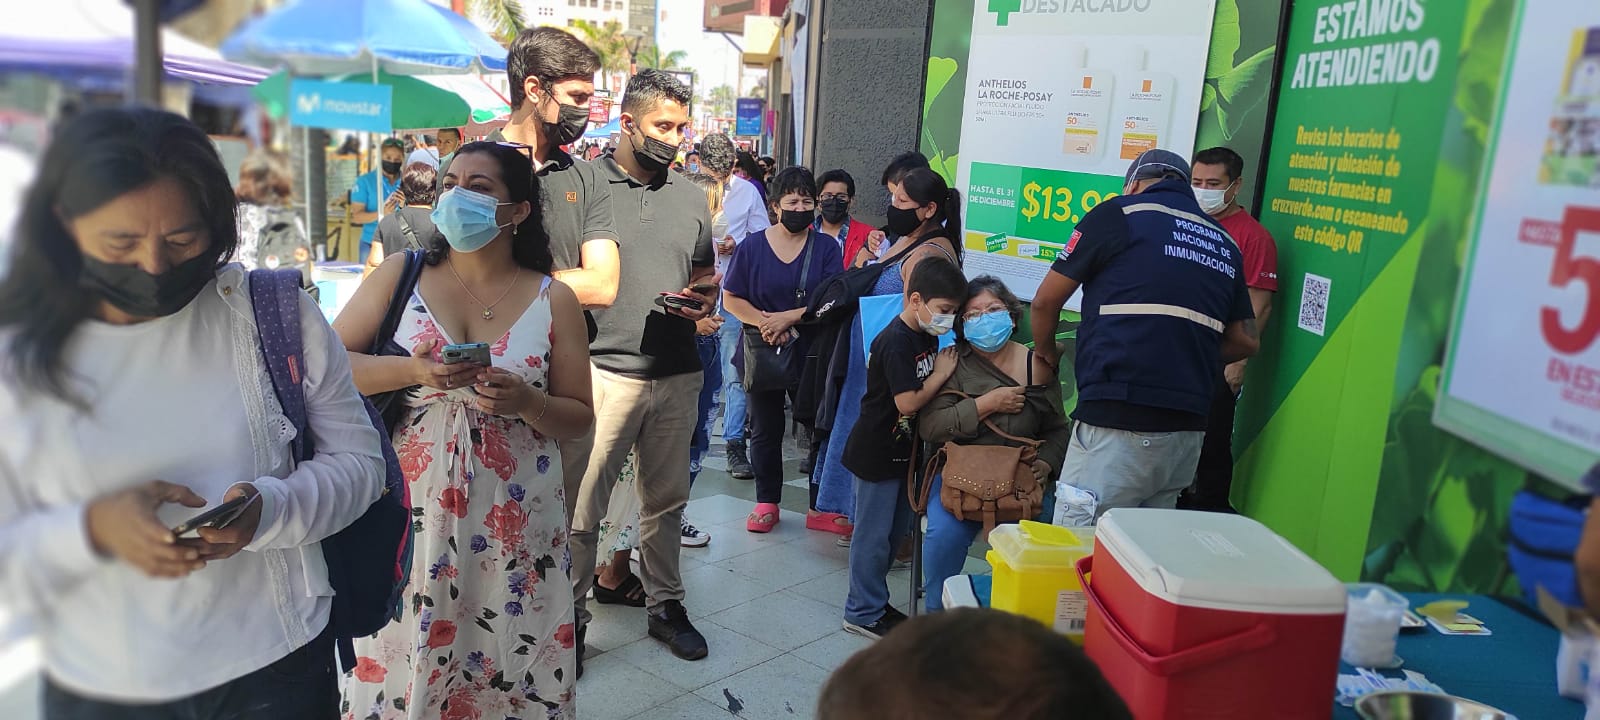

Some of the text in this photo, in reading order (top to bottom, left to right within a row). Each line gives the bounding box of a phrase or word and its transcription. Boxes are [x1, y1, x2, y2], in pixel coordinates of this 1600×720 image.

[1022, 0, 1150, 13] DESTACADO
[1313, 0, 1425, 44] ESTAMOS
[1291, 38, 1440, 89] ATENDIENDO
[978, 80, 1027, 89] ANTHELIOS
[978, 90, 1053, 102] LA ROCHE-POSAY
[323, 98, 382, 117] movistar
[1296, 125, 1401, 149] Revisa los horarios de
[1289, 151, 1401, 177] atención y ubicación de
[970, 185, 1014, 197] HASTA EL 31
[970, 195, 1015, 208] DE DICIEMBRE
[1021, 181, 1119, 223] $13.9
[1288, 175, 1392, 204] nuestras farmacias en
[1271, 197, 1409, 235] cruzverde.com o escaneando
[1175, 219, 1224, 243] PROGRAMA
[1294, 225, 1364, 254] este código QR
[1173, 231, 1232, 260] NACIONAL DE
